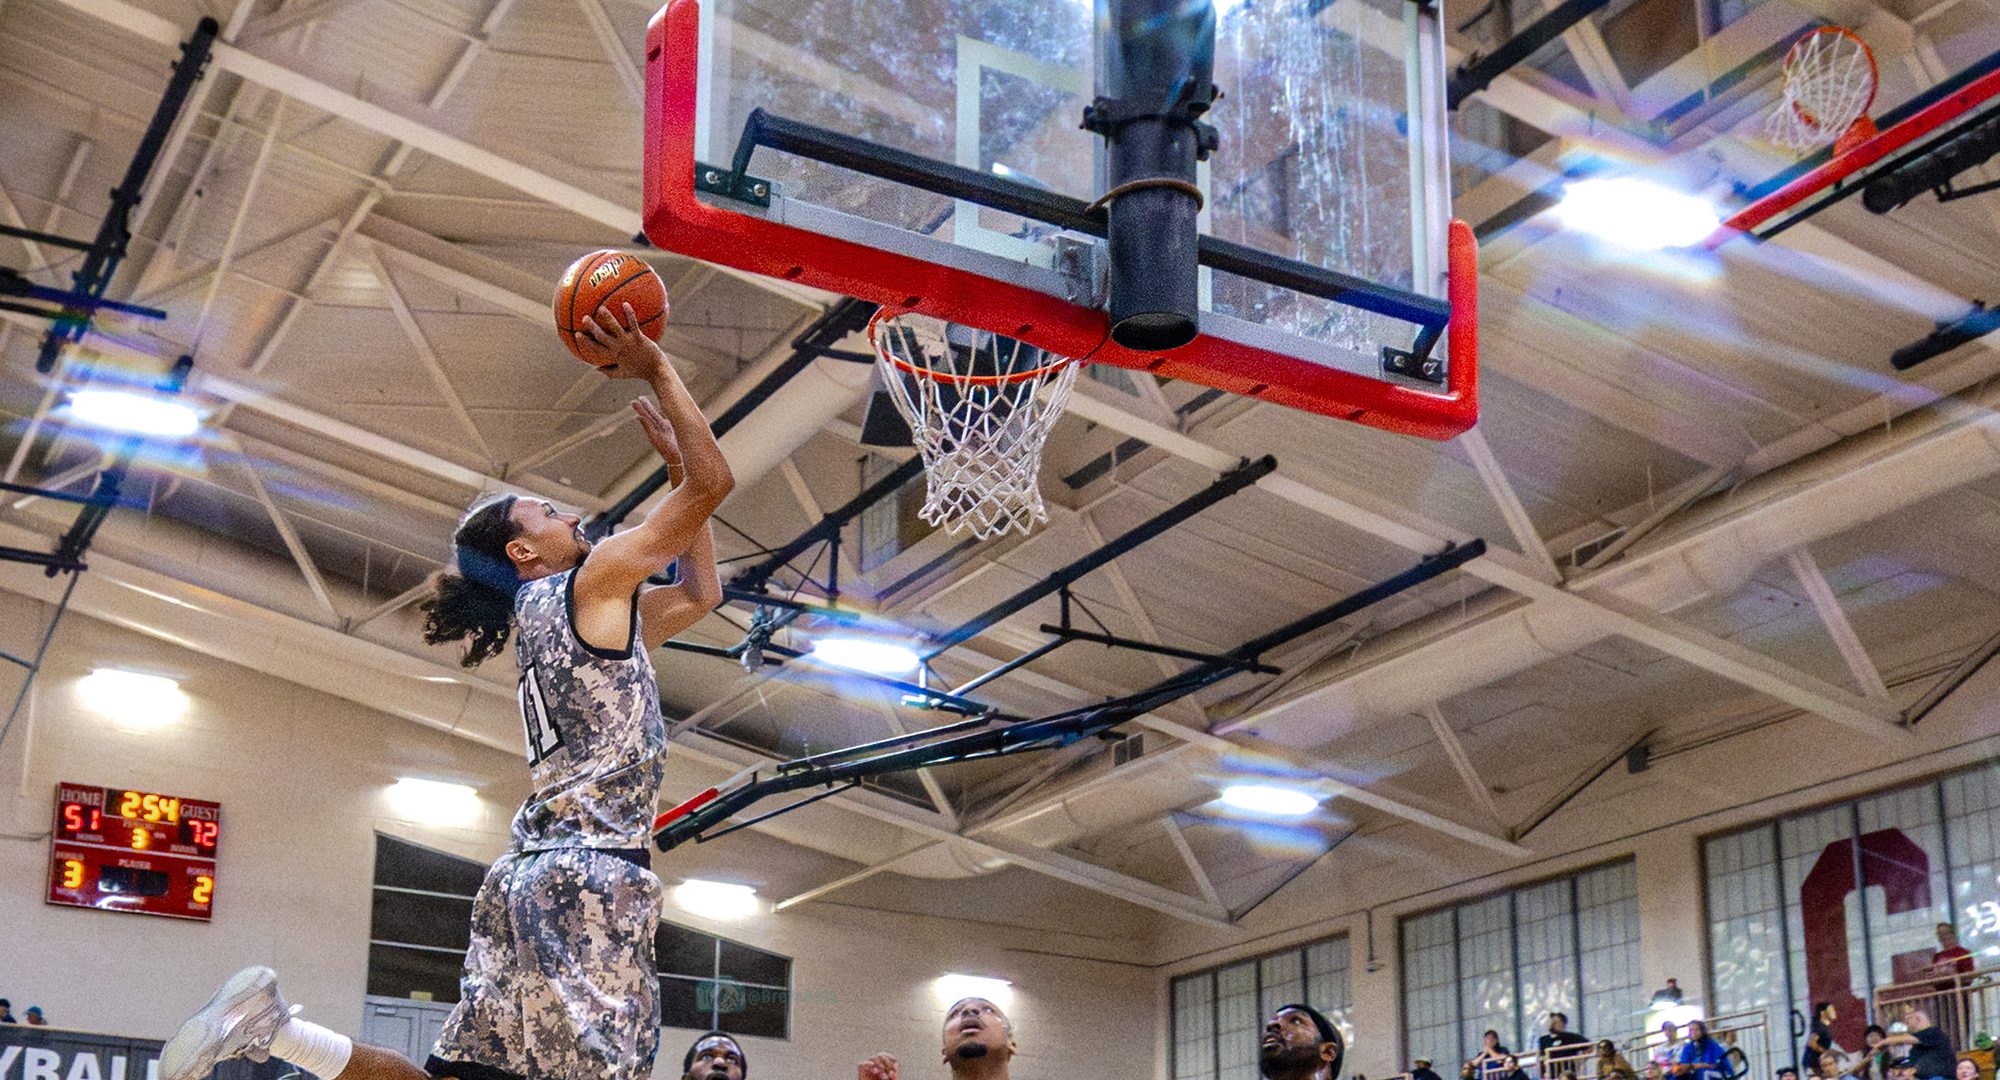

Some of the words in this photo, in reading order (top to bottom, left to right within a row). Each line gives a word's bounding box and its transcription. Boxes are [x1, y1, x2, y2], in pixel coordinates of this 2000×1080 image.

[60, 789, 101, 806] HOME
[64, 804, 99, 831] 51
[180, 804, 219, 820] GUEST
[131, 828, 148, 849] 3
[188, 820, 218, 847] 72
[64, 860, 82, 888] 3
[193, 876, 213, 903] 2
[1801, 827, 1938, 1053] C
